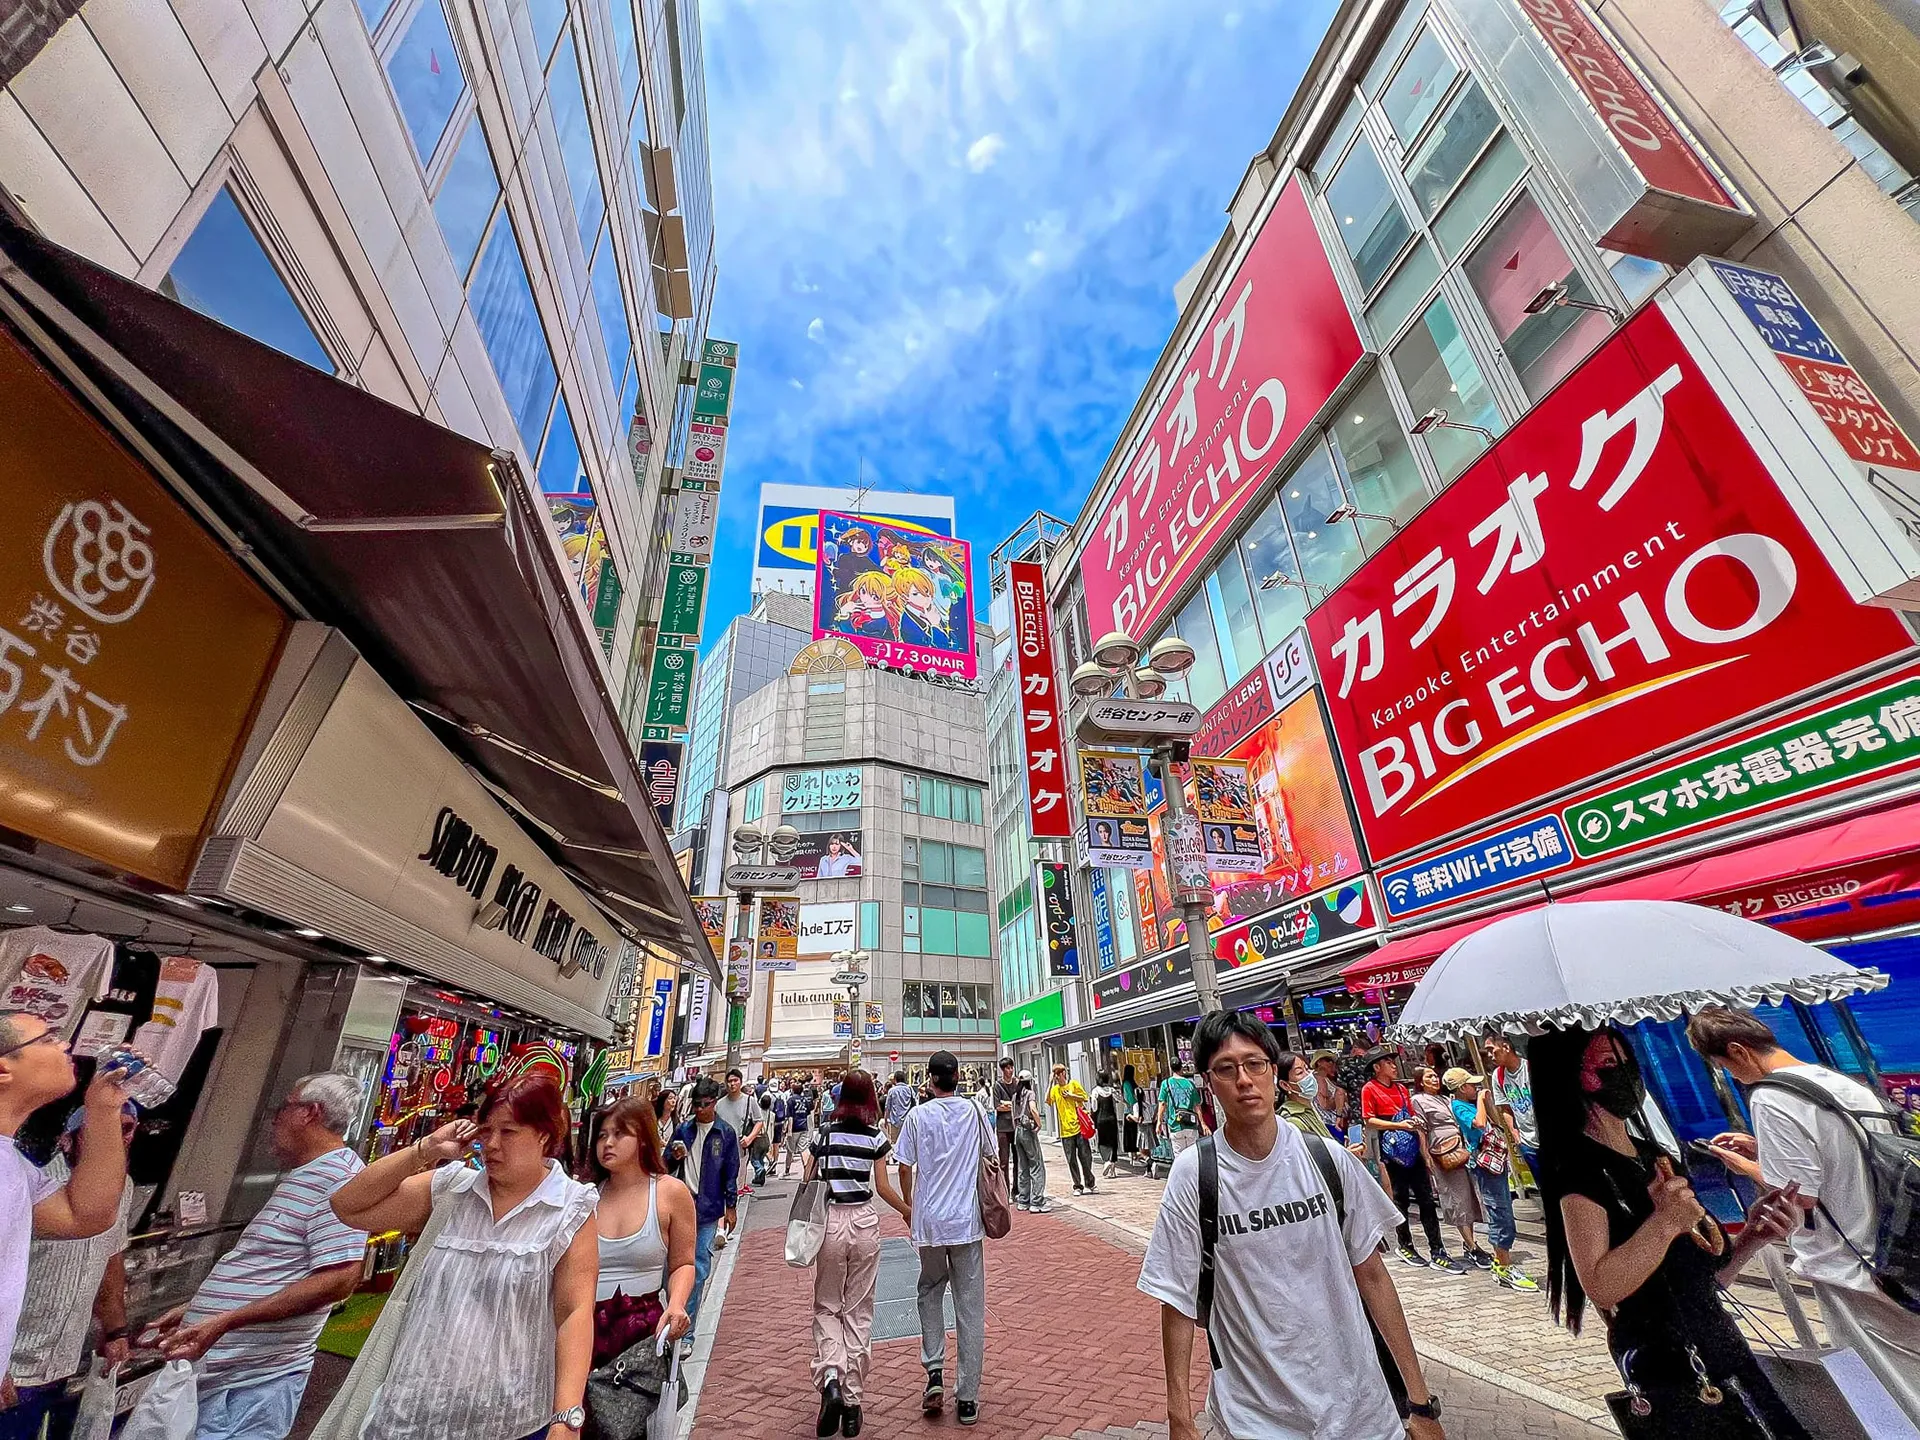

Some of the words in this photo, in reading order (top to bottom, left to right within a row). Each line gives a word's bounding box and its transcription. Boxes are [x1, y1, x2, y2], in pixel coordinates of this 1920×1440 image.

[1570, 52, 1662, 151] ECHO
[1740, 273, 1798, 309] 渋谷
[1758, 324, 1835, 358] クリニック
[1814, 368, 1875, 407] 渋谷
[1103, 278, 1254, 571] カラオケ
[1810, 400, 1896, 436] コンタクト
[685, 481, 702, 489] 3F
[1118, 523, 1157, 580] Karaoke
[1157, 377, 1251, 522] Entertainment
[1111, 540, 1168, 638] BIG
[1171, 377, 1287, 556] ECHO
[1330, 363, 1684, 700] カラオケ
[674, 554, 691, 563] 2F
[1016, 581, 1035, 611] BIG
[18, 593, 101, 666] 渋谷
[662, 637, 680, 646] 1F
[1022, 613, 1040, 658] ECHO
[1371, 668, 1453, 729] Karaoke
[1459, 519, 1686, 673] Entertainment
[895, 647, 919, 663] 7.3
[1358, 699, 1482, 819] BIG
[1486, 532, 1799, 728] ECHO
[652, 681, 668, 721] フルーツ
[1096, 707, 1195, 724] 渋谷センター街
[1194, 700, 1236, 743] CONTACT
[1235, 675, 1263, 708] LENS
[647, 728, 665, 739] B1
[1024, 673, 1062, 814] カラオケ
[804, 772, 860, 790] れいわ
[785, 791, 860, 811] クリニック
[729, 871, 796, 881] 渋谷センター街
[1411, 824, 1563, 899] 無料Wi-Fi完備
[1773, 890, 1808, 910] BIG
[1810, 879, 1861, 899] ECHO
[1252, 932, 1264, 948] B1
[1367, 971, 1400, 985] カラオケ
[1402, 969, 1416, 980] BIG
[1249, 1193, 1328, 1233] SANDER
